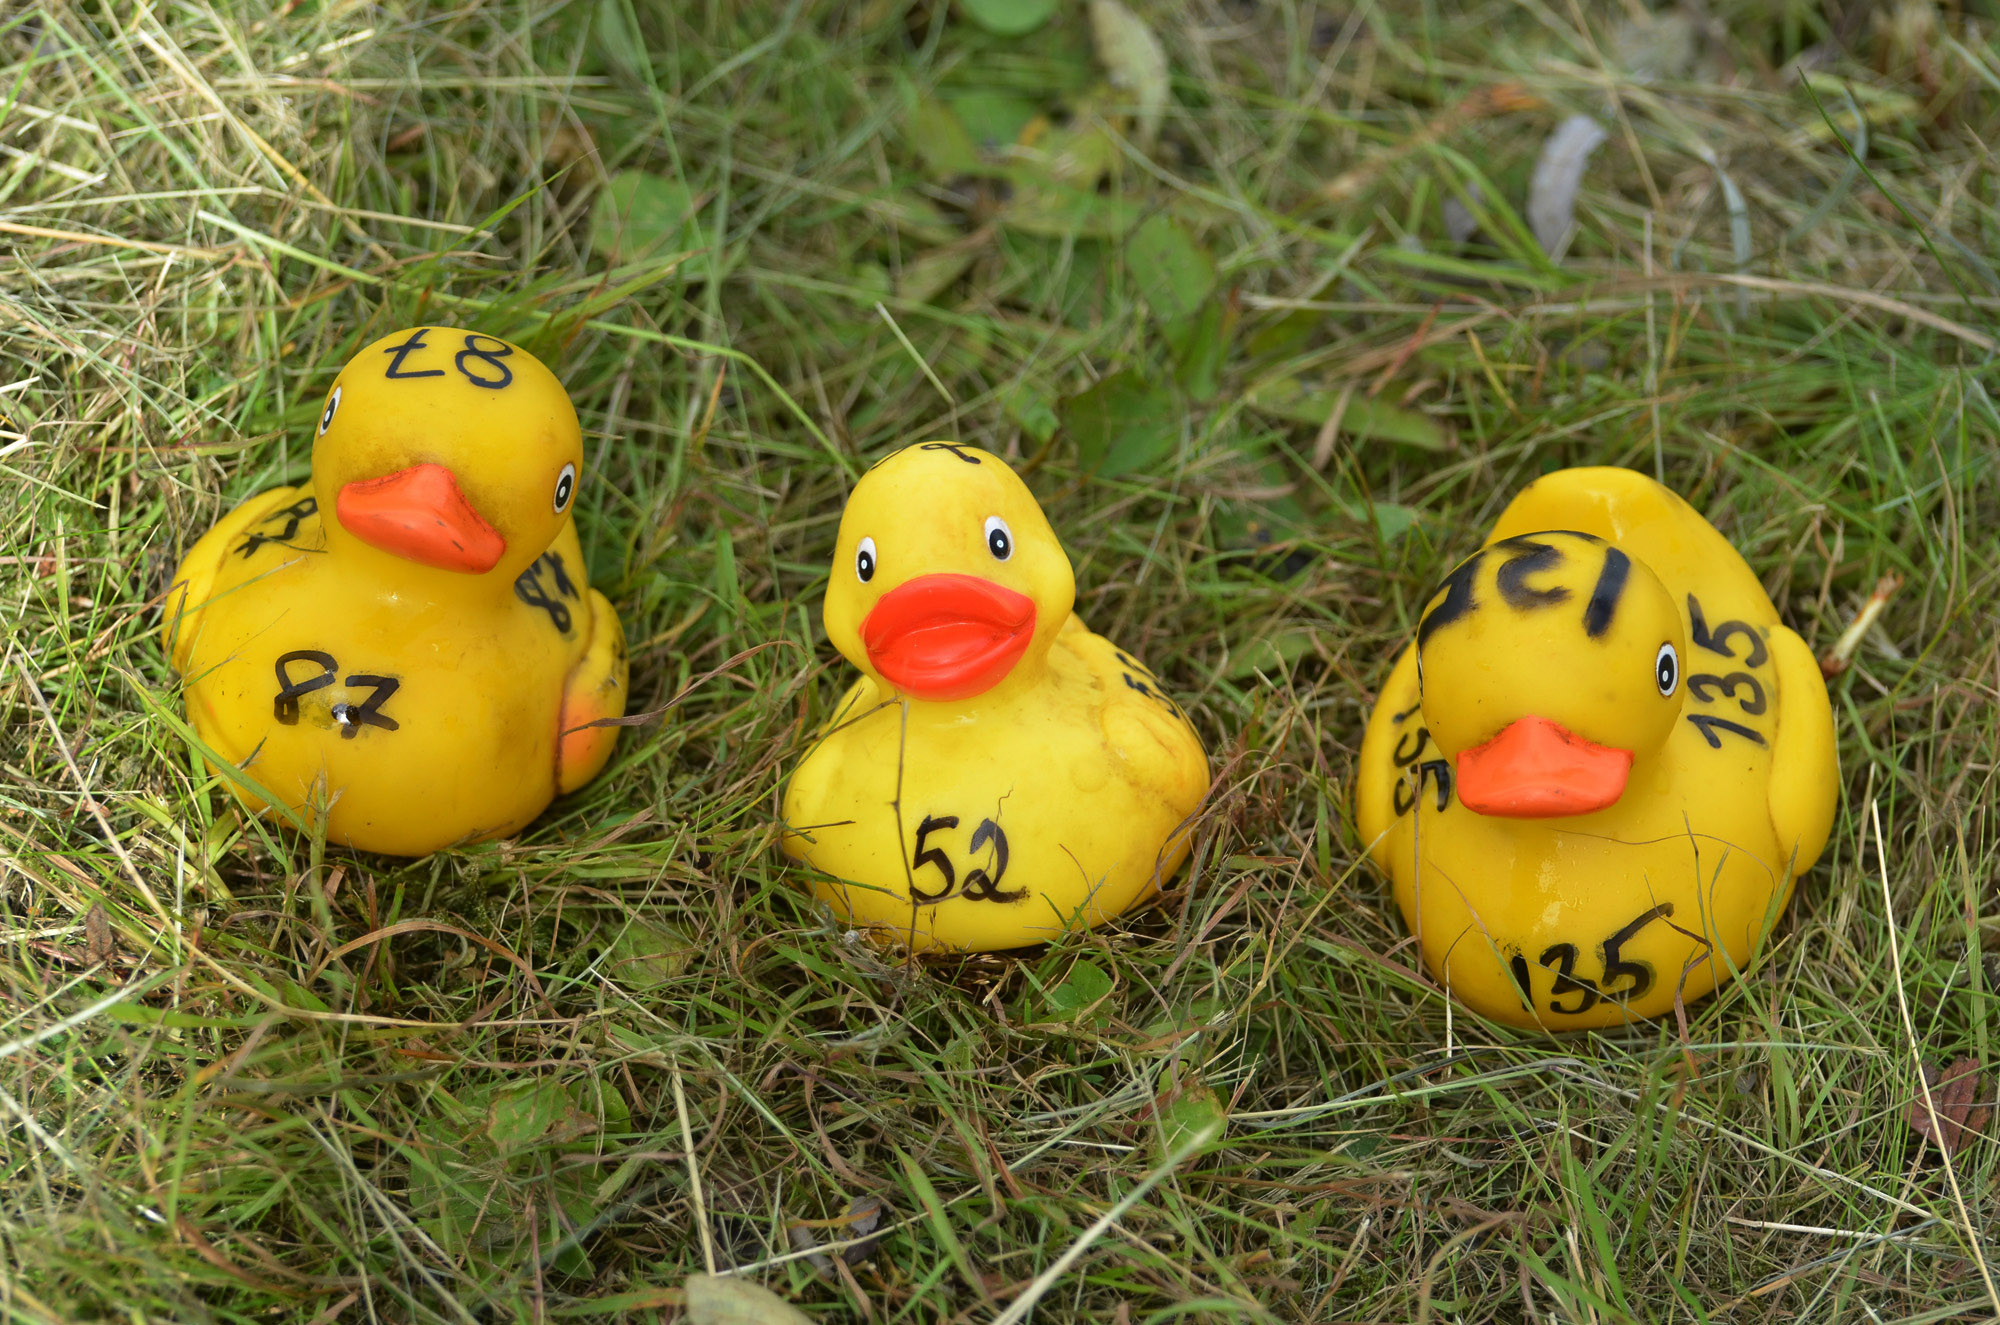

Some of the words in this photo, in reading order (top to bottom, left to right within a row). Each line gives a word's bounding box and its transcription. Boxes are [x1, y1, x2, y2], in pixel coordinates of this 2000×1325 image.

[384, 328, 514, 390] 87
[273, 649, 401, 740] 87
[1687, 592, 1769, 750] 135
[909, 814, 1031, 903] 52
[1509, 901, 1675, 1015] 135
